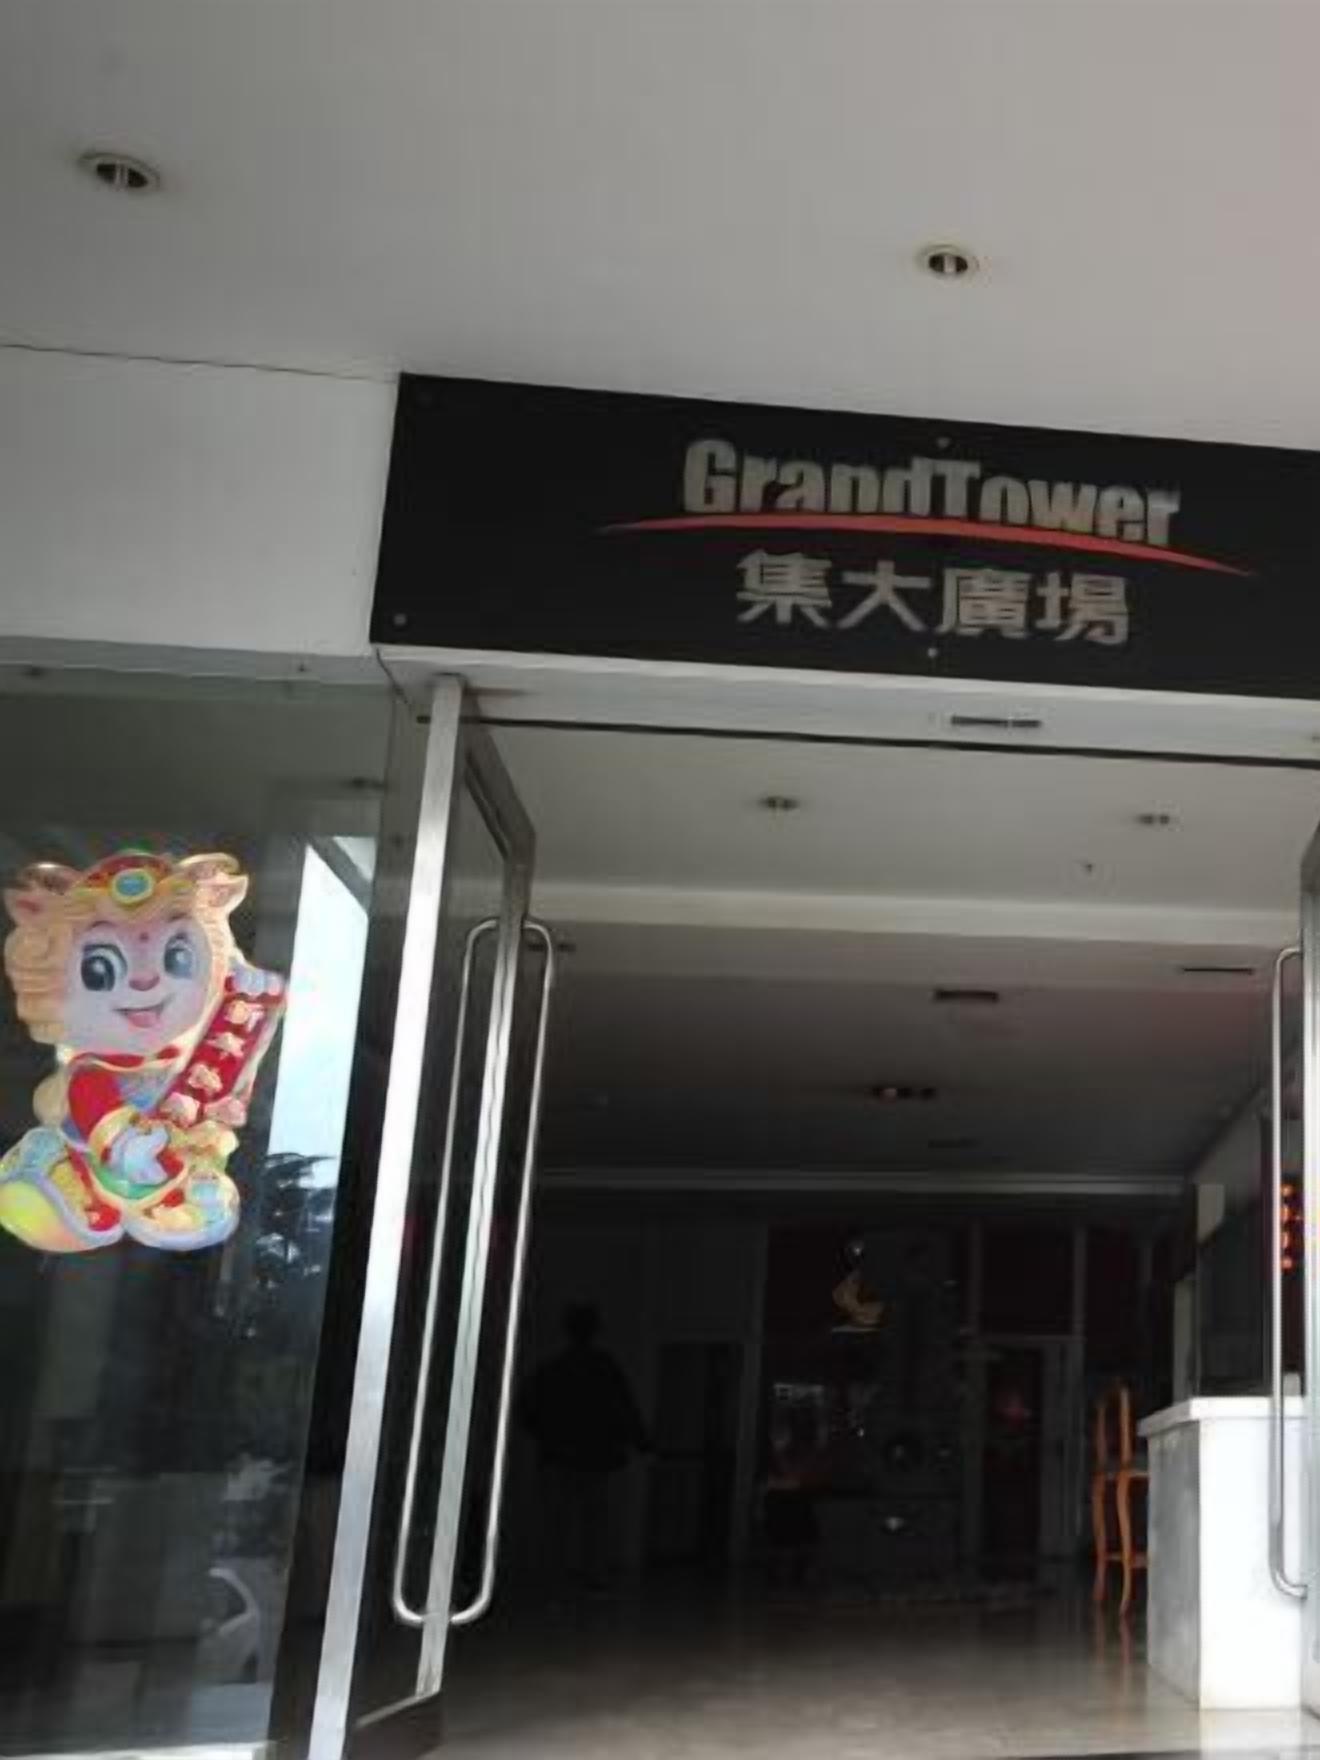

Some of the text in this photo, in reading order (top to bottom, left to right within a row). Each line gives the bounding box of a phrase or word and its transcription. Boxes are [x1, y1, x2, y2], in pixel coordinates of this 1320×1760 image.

[683, 437, 1181, 546] GrandTower
[736, 548, 1131, 646] 集大廣場
